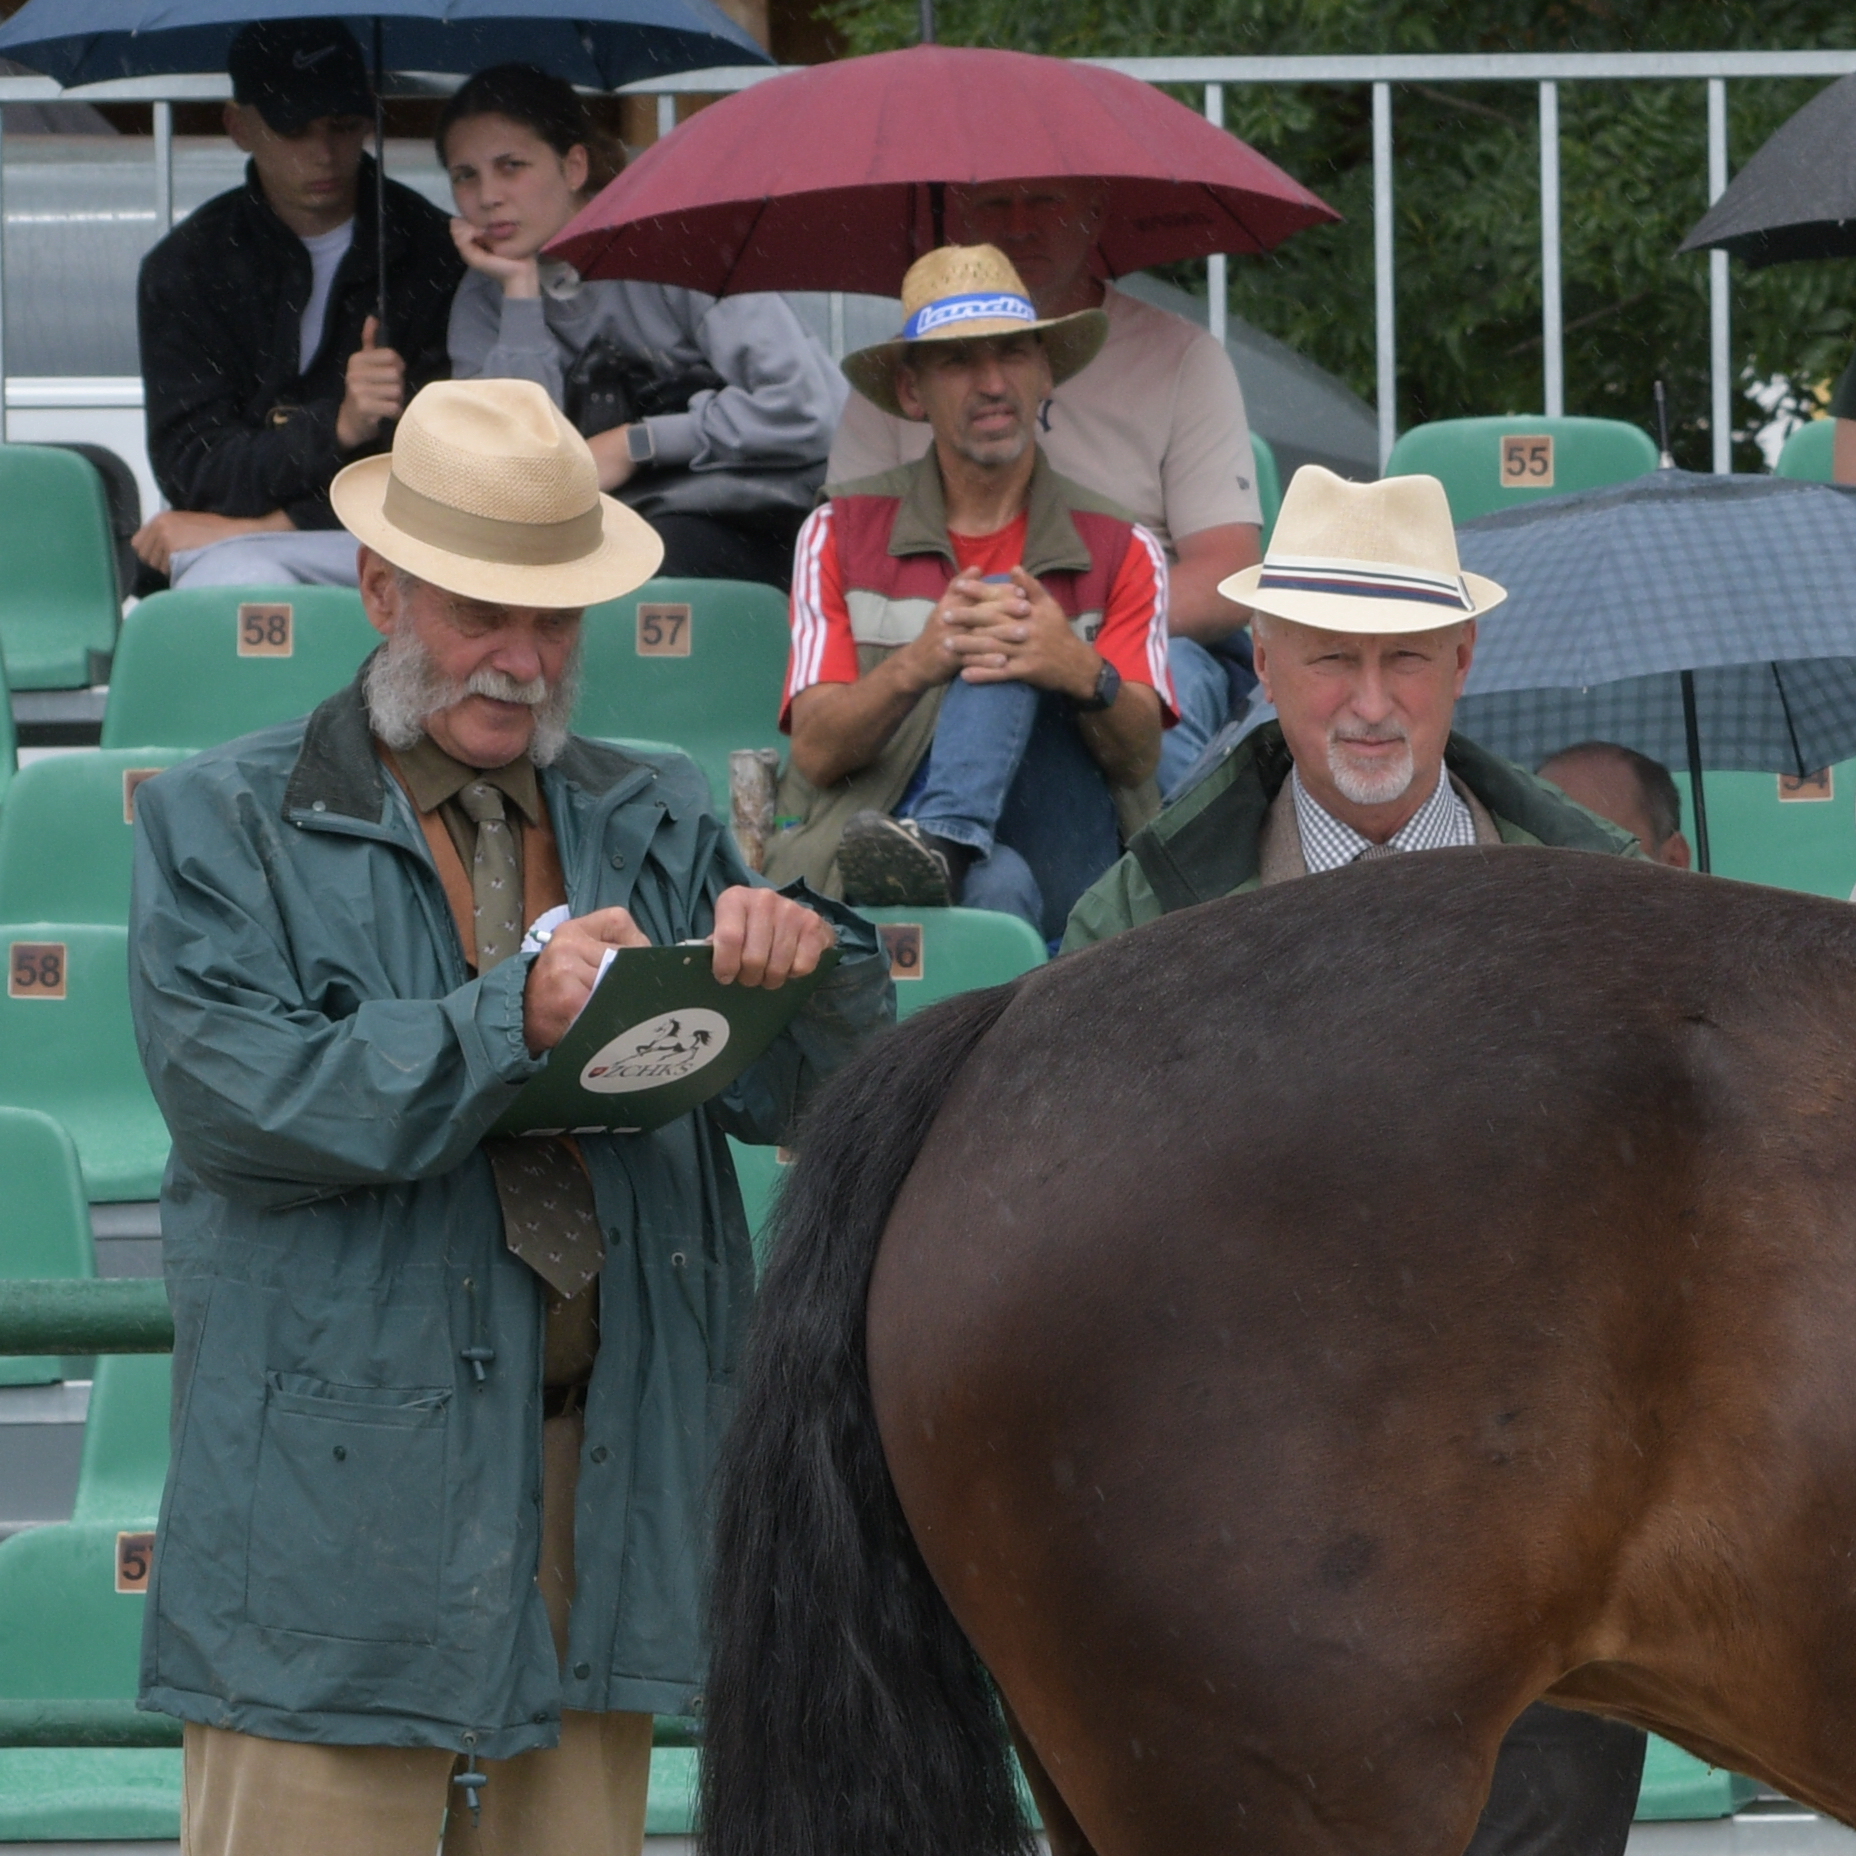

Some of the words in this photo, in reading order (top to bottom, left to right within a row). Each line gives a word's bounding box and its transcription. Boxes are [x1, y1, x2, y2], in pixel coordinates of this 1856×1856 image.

[1506, 446, 1549, 478] 55
[244, 615, 287, 647] 58
[643, 614, 686, 647] 57
[15, 953, 61, 989] 58
[122, 1543, 154, 1581] 5
